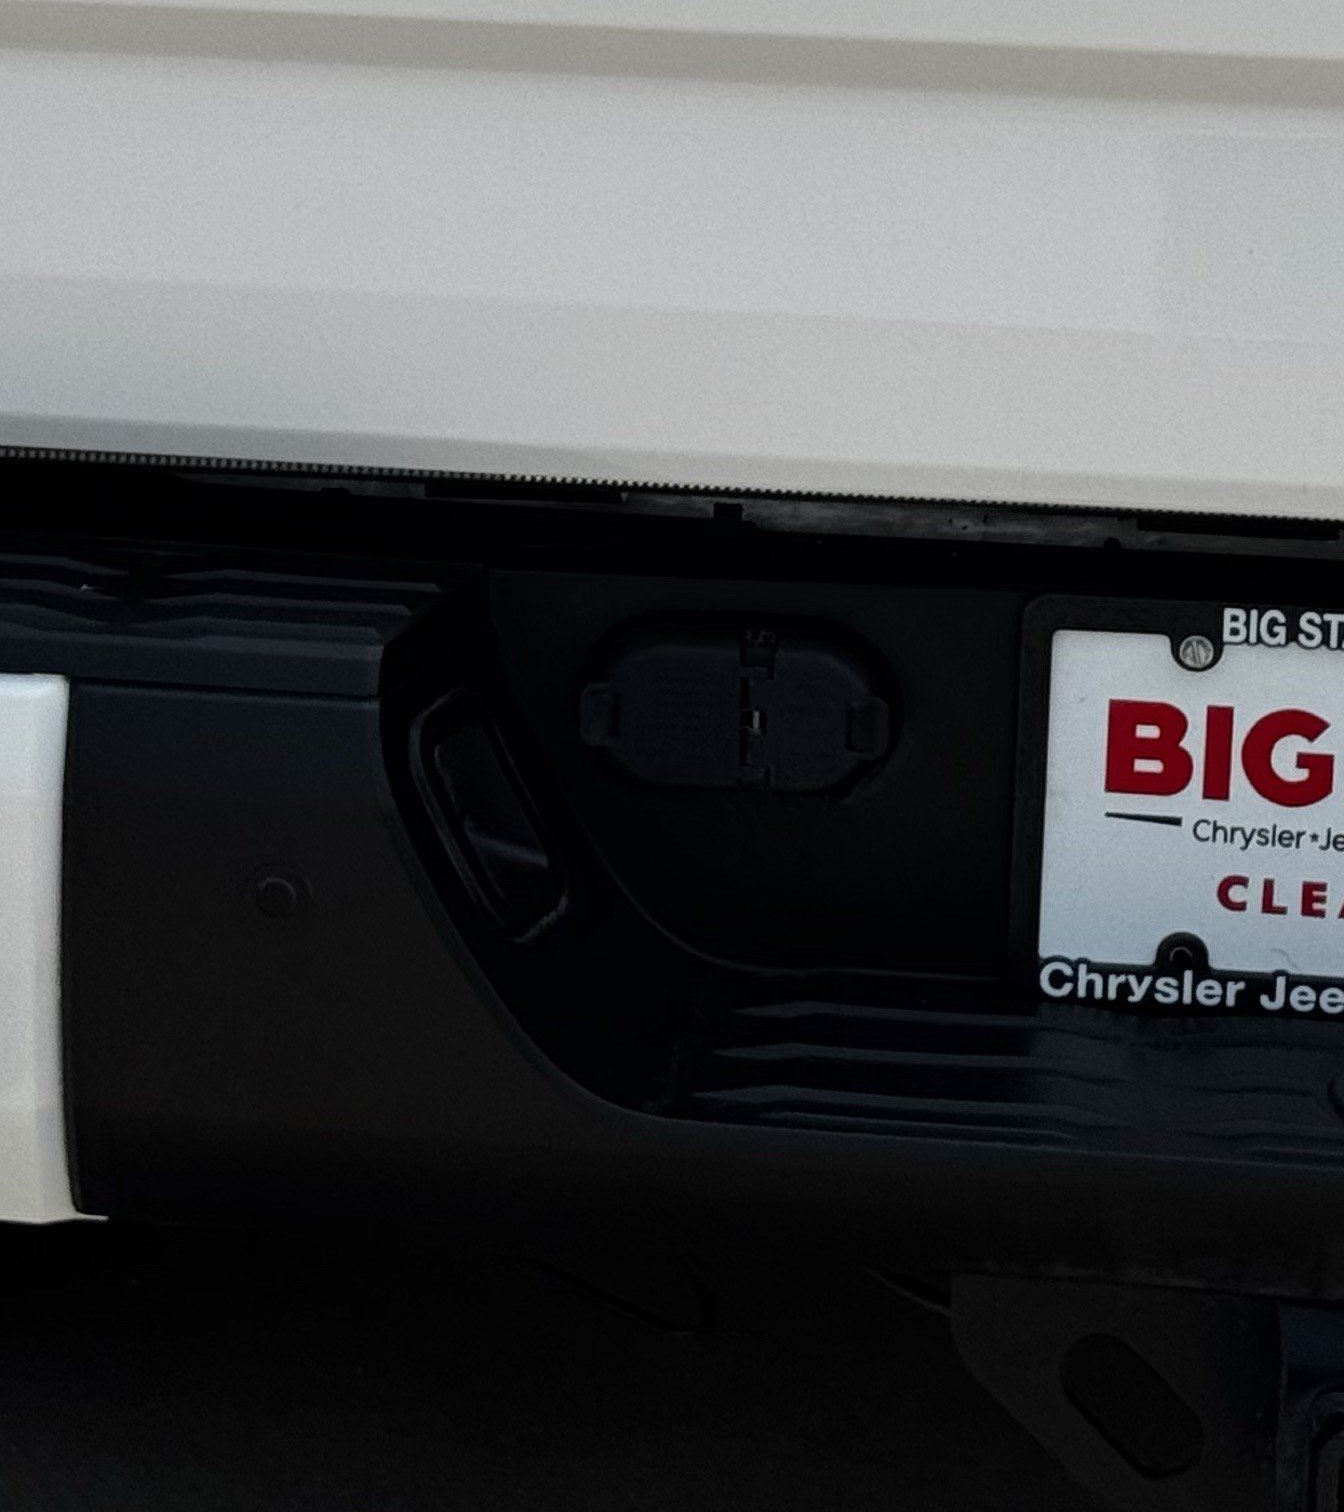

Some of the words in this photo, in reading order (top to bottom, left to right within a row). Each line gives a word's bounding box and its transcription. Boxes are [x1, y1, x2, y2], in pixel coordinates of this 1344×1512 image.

[1222, 607, 1287, 646] BIG
[1103, 698, 1335, 808] BIG
[1191, 818, 1306, 851] Chrysler
[1038, 960, 1246, 1011] Chrysler
